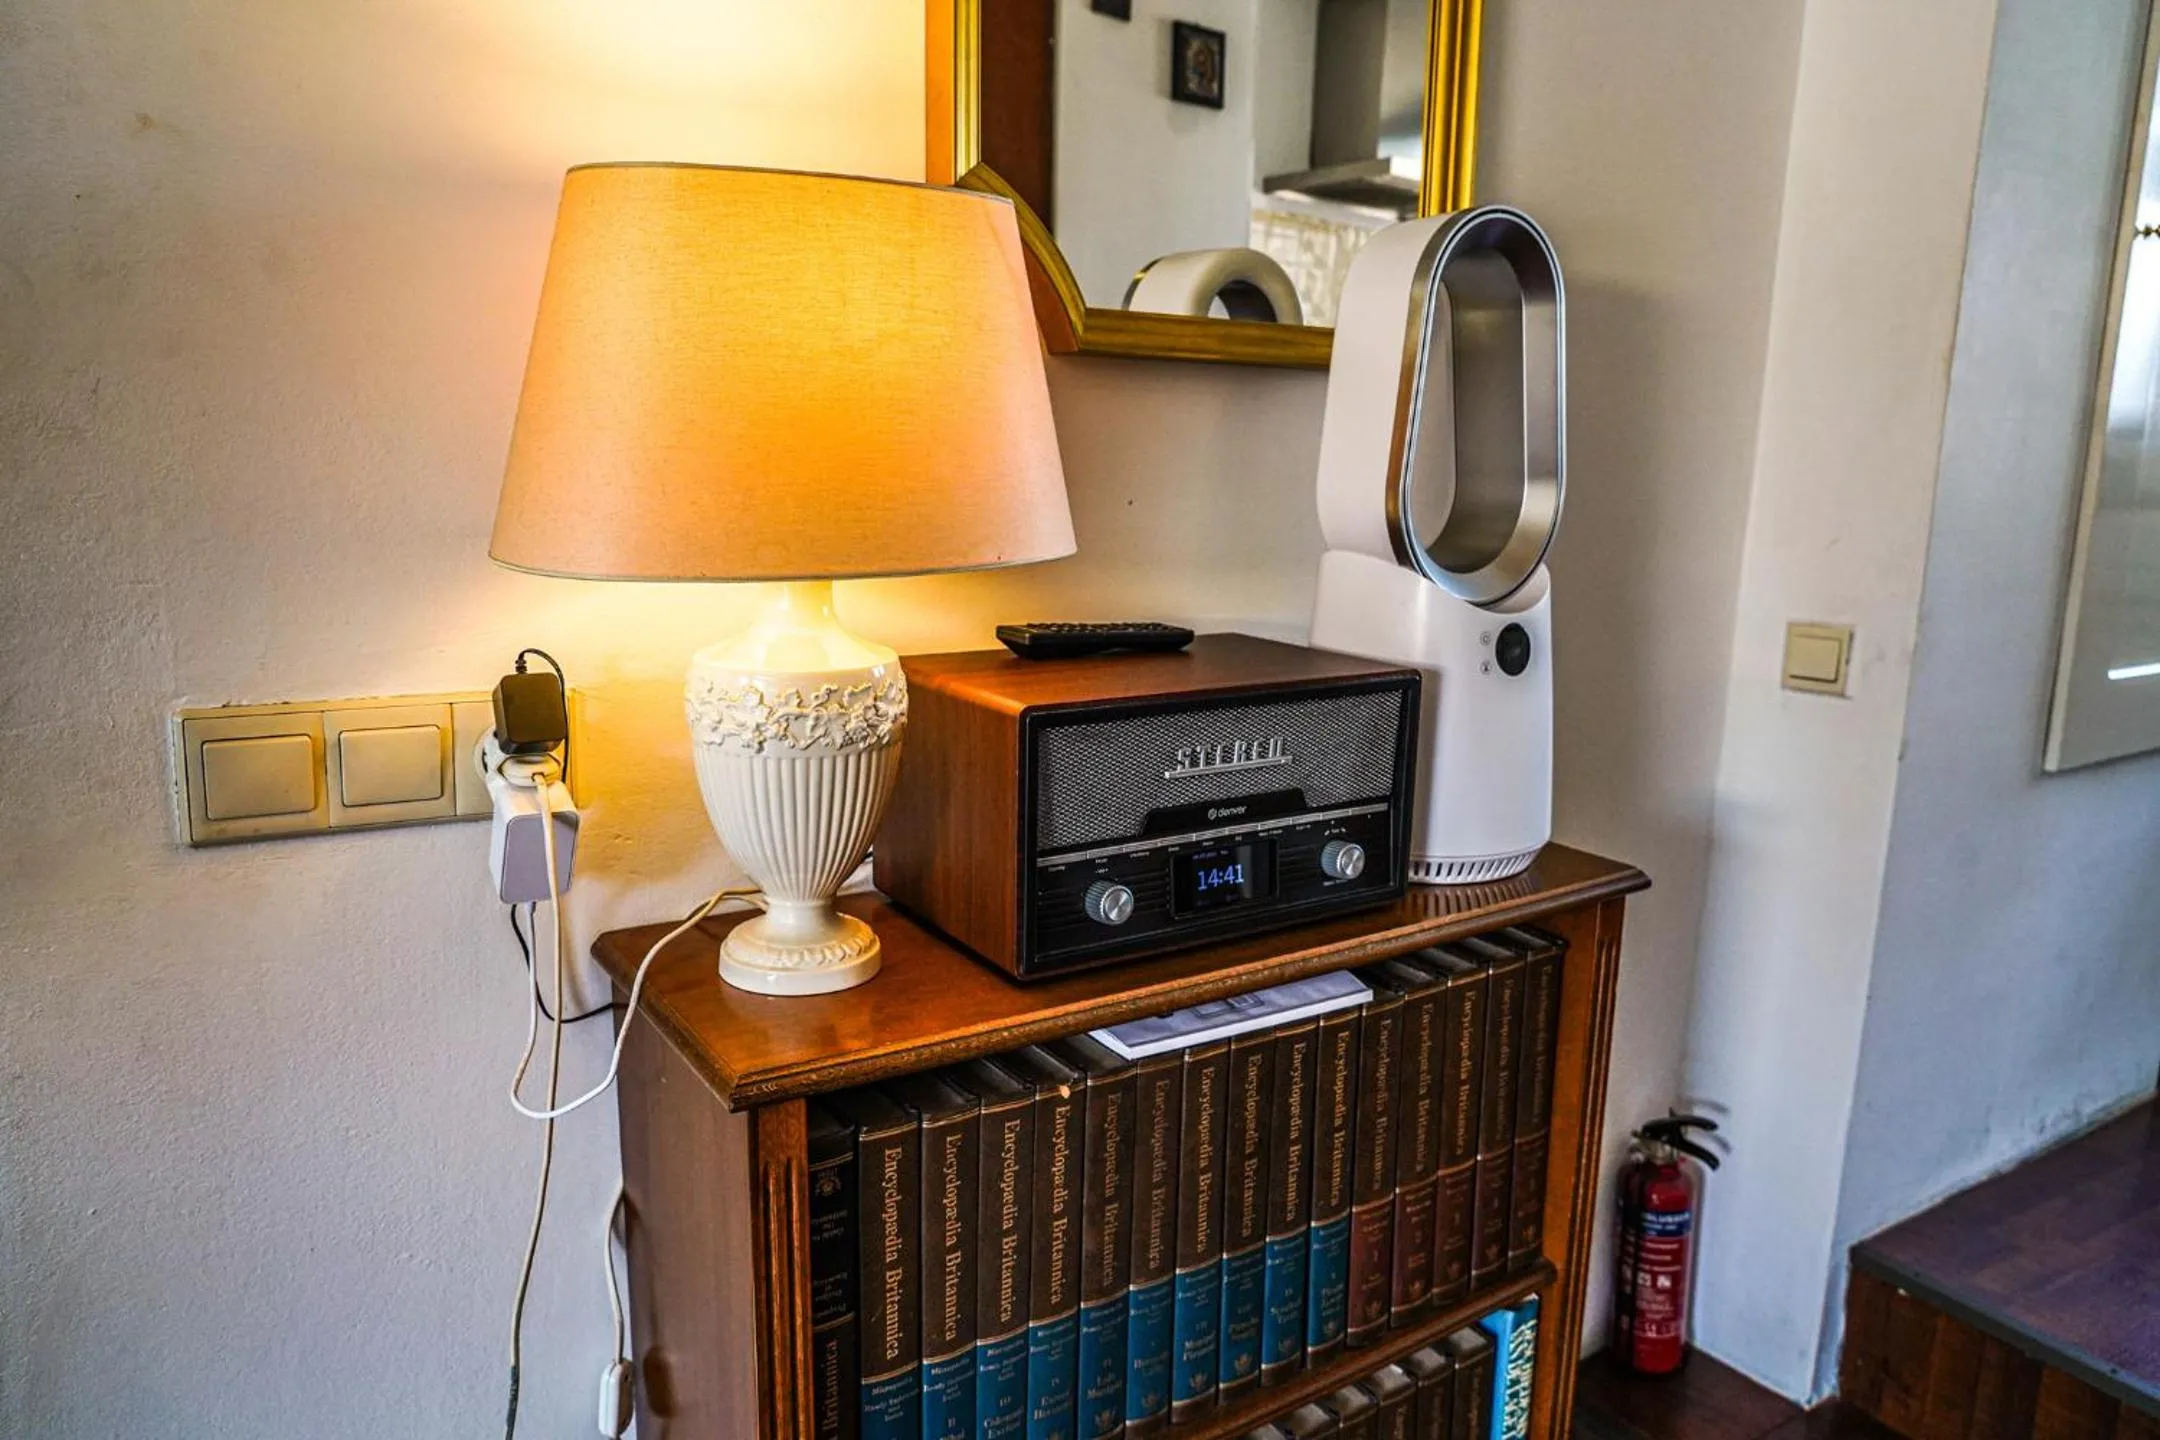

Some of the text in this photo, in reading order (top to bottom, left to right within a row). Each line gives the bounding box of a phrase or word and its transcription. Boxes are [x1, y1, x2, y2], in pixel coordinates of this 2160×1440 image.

[1216, 804, 1248, 819] denver
[1197, 863, 1245, 891] 14:41
[945, 1251, 962, 1341] Britannica
[1000, 1234, 1018, 1322] Britannica
[1050, 1216, 1068, 1305] Britannica
[885, 1266, 904, 1361] Britannica
